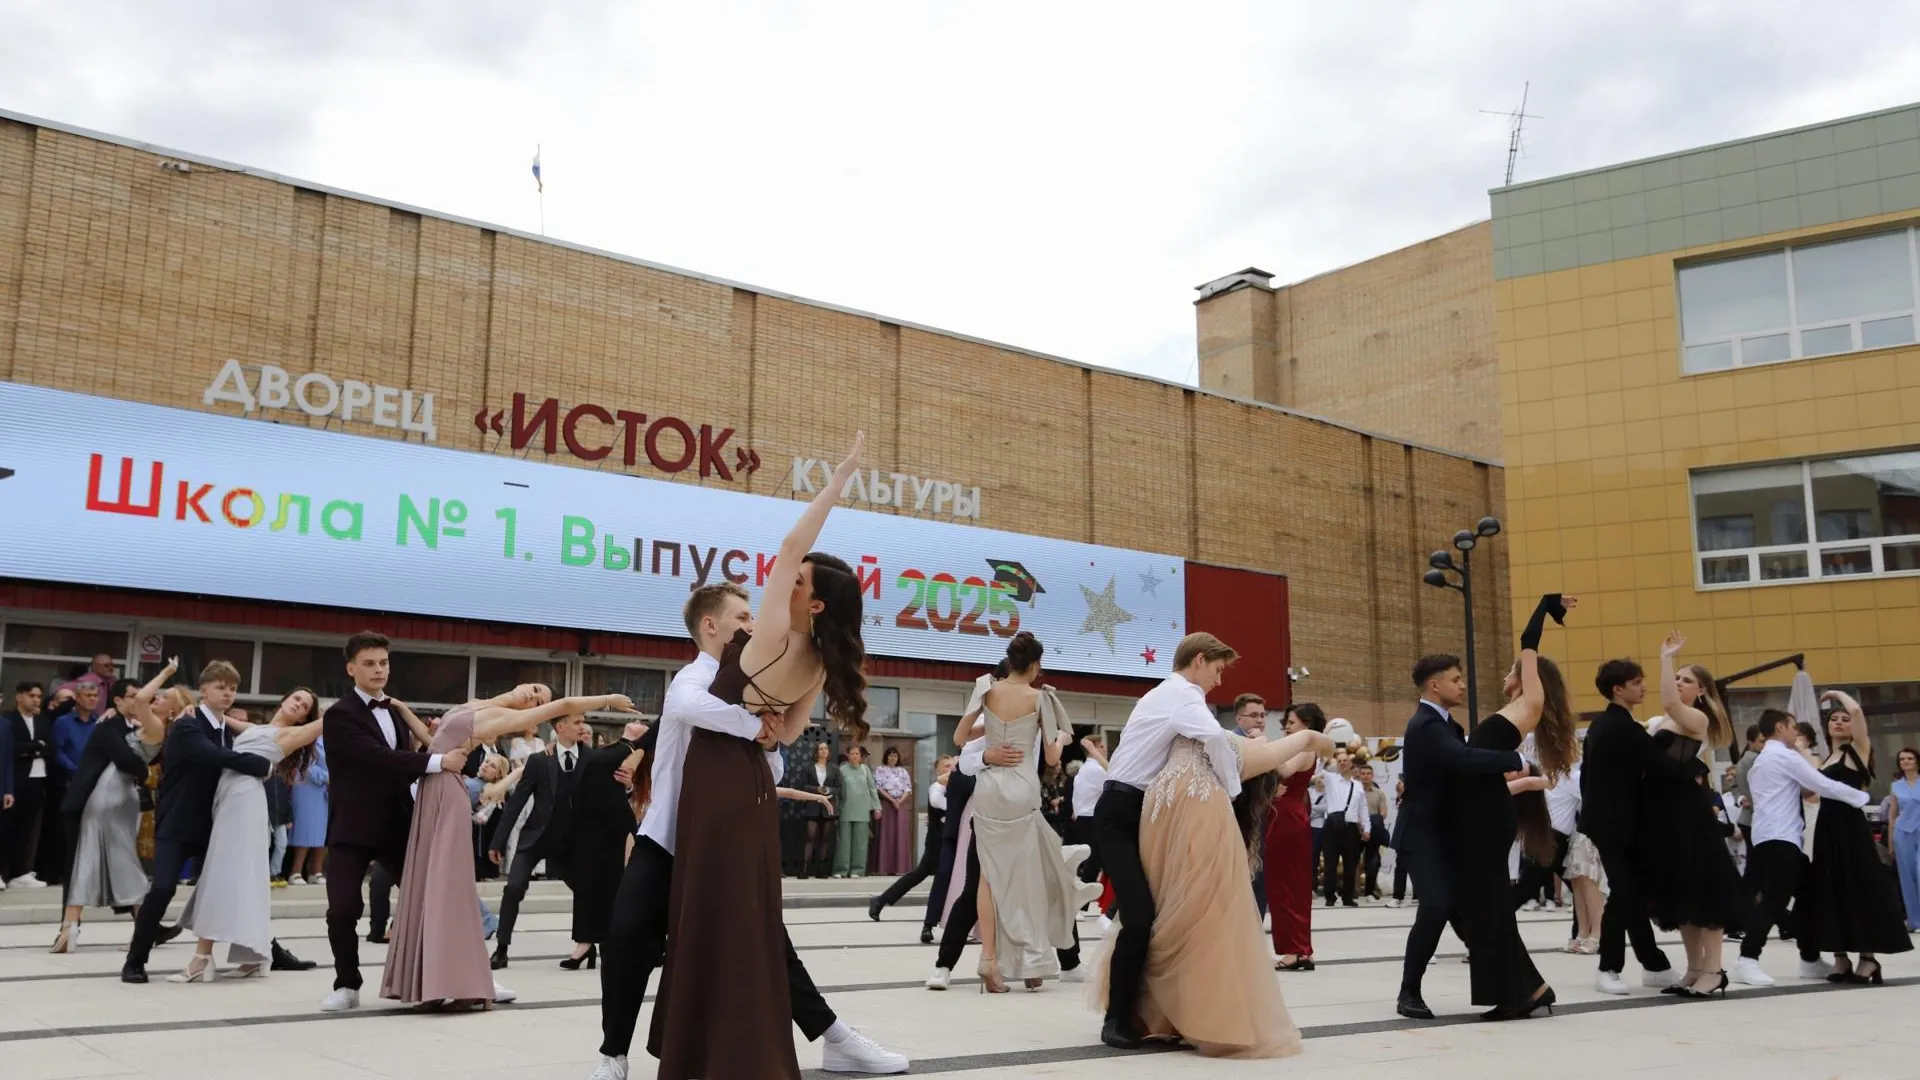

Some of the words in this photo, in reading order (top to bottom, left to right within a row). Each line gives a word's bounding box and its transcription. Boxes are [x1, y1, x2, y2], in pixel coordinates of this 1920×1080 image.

[203, 359, 436, 440] ДВОРЕЦ
[475, 392, 760, 481] «ИСТОК»
[86, 453, 363, 540] Школа
[396, 493, 468, 549] №
[495, 507, 533, 562] 1.
[561, 515, 881, 600] Выпускй
[896, 568, 1020, 638] 2025
